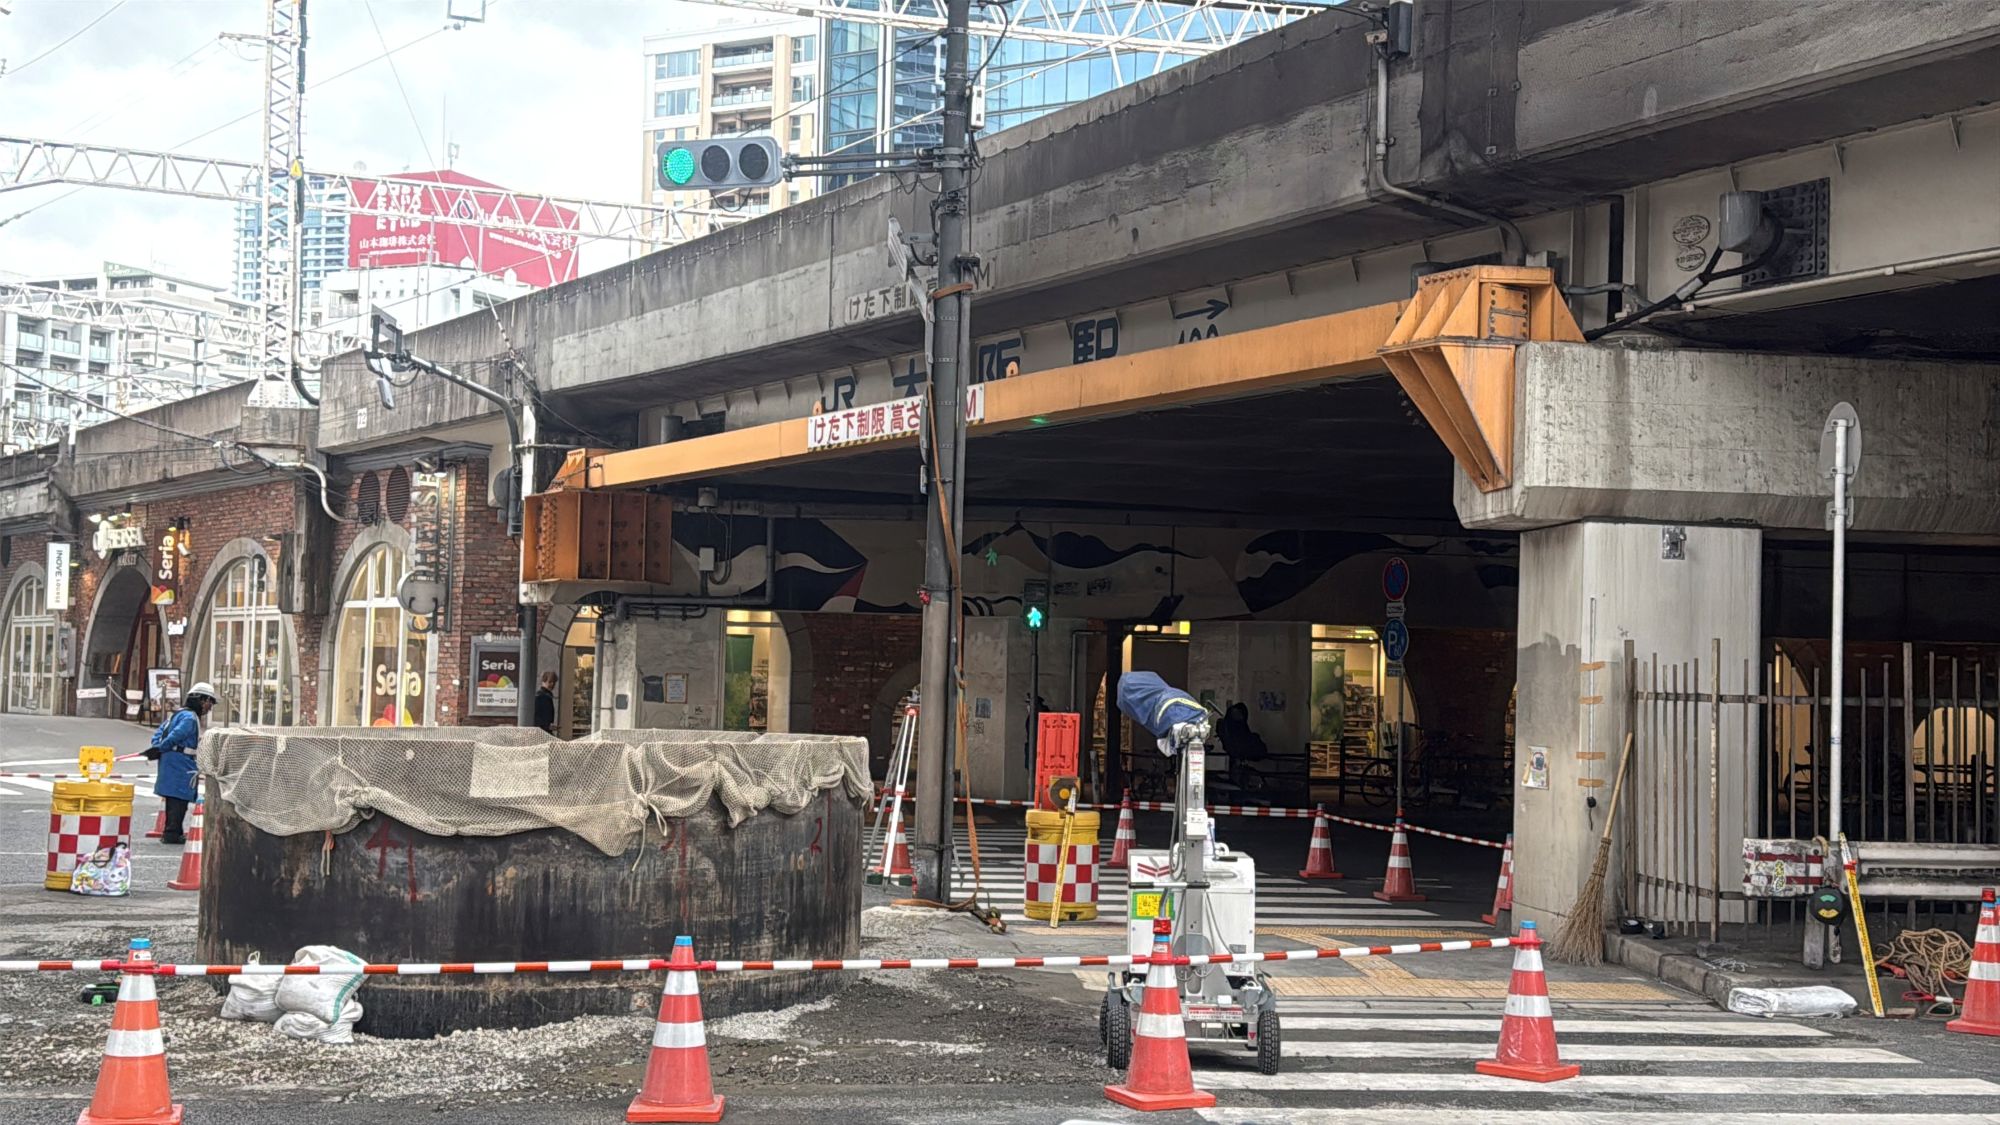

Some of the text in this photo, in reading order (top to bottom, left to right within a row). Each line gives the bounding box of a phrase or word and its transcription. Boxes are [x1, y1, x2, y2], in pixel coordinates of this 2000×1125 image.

[821, 375, 856, 413] JR
[55, 550, 64, 577] INOVE
[158, 535, 175, 580] Seria
[1387, 630, 1398, 657] P
[481, 659, 516, 671] Seria
